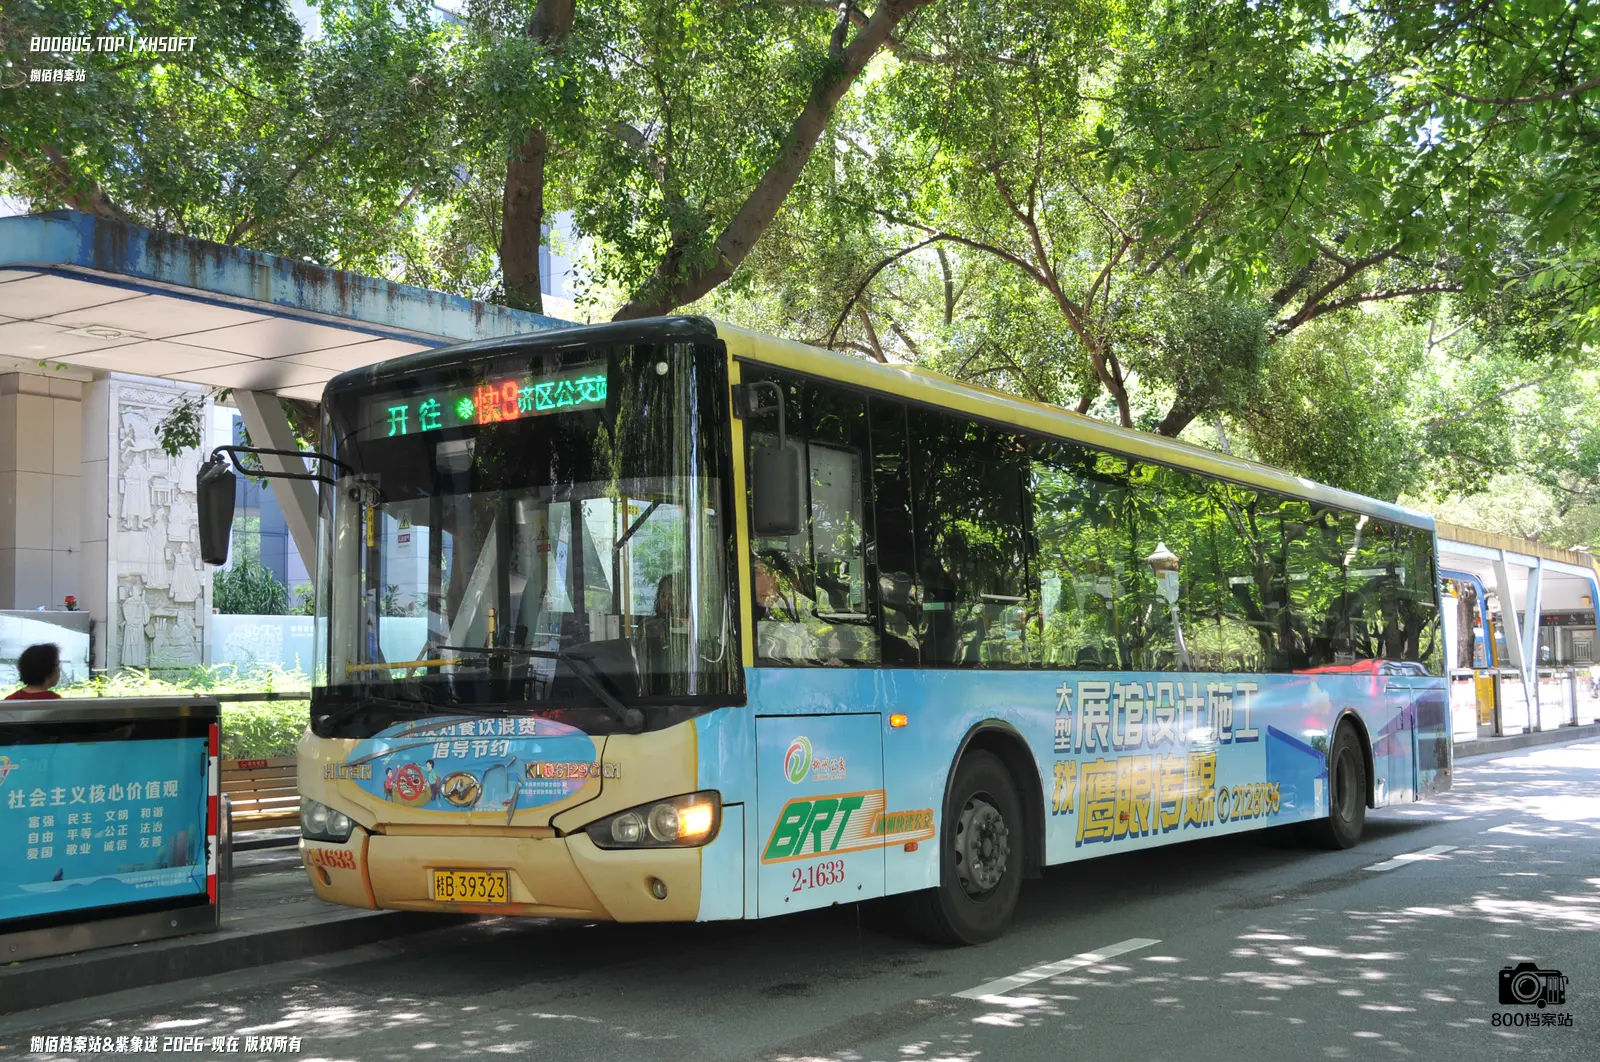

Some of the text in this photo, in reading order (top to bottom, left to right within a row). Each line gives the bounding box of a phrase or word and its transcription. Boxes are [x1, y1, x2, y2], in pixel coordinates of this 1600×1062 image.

[387, 397, 442, 436] 开往
[475, 380, 520, 424] 快8
[1054, 681, 1072, 753] 大型
[1074, 681, 1259, 755] 展馆设计施工
[432, 739, 510, 759] 倡导节约
[8, 780, 178, 809] 社会主义核心价值观
[28, 806, 164, 829] 富强 民主 文明 和谐
[28, 821, 163, 845] 自由 平等 公正 法治
[763, 795, 865, 860] BRT
[26, 836, 162, 860] 爱国 敬业 诚信 友善
[791, 859, 845, 892] 2-1633
